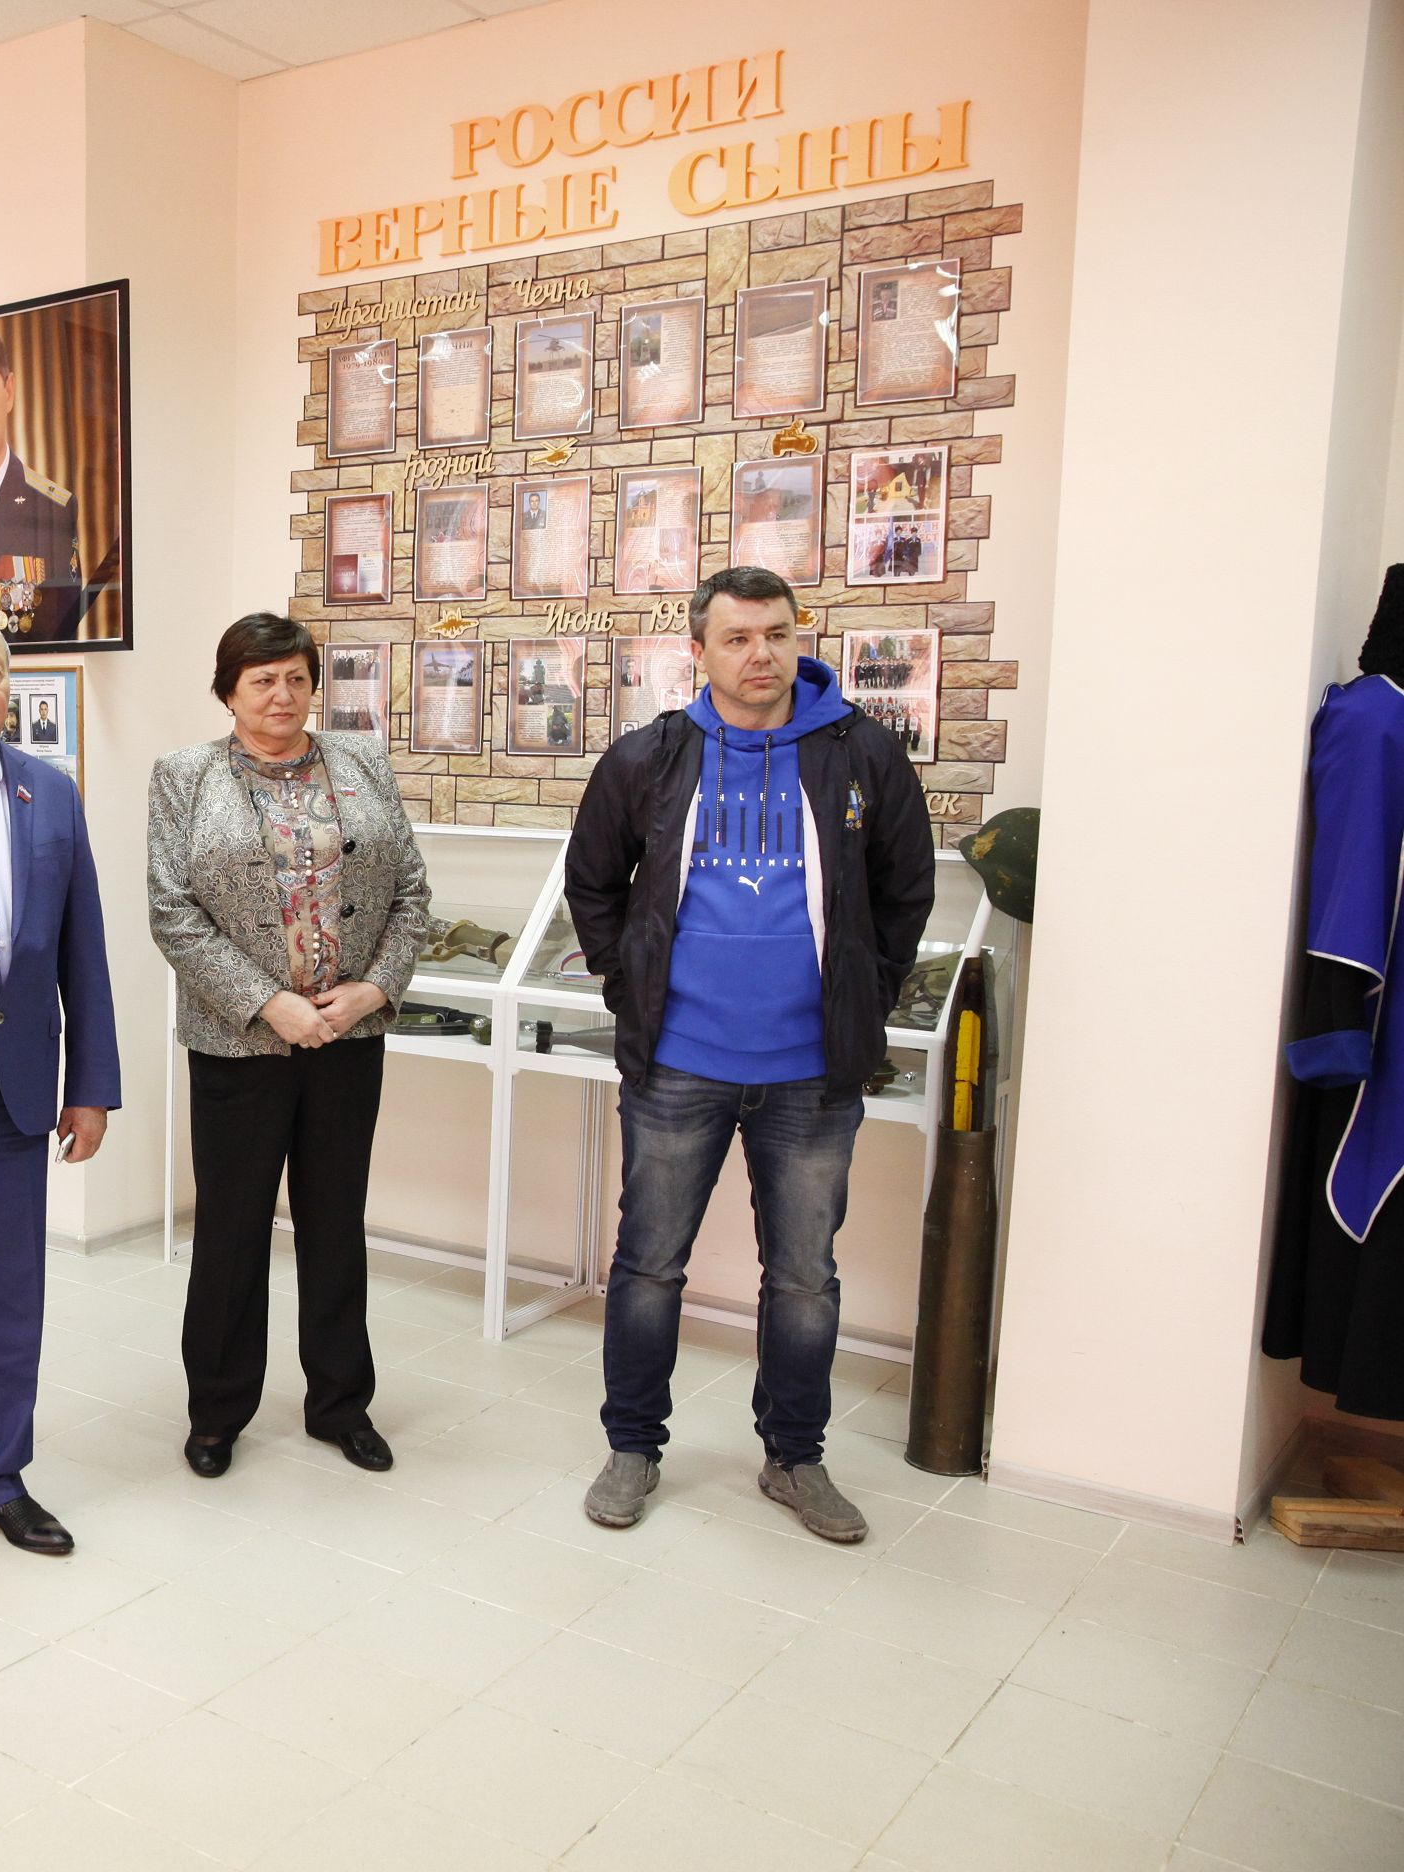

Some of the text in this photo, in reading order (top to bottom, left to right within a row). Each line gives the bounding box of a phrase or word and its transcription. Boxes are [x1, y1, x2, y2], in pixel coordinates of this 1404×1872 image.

[450, 50, 785, 180] РОССИИ
[317, 100, 971, 276] ВЕРНЫЕ СЫНЫ
[511, 277, 593, 308] Чечня
[324, 289, 480, 339] Афганистан
[404, 447, 496, 492] Грозный
[544, 600, 691, 632] Июнь 199
[697, 792, 786, 802] THLET
[690, 858, 803, 868] DEPARTMEN
